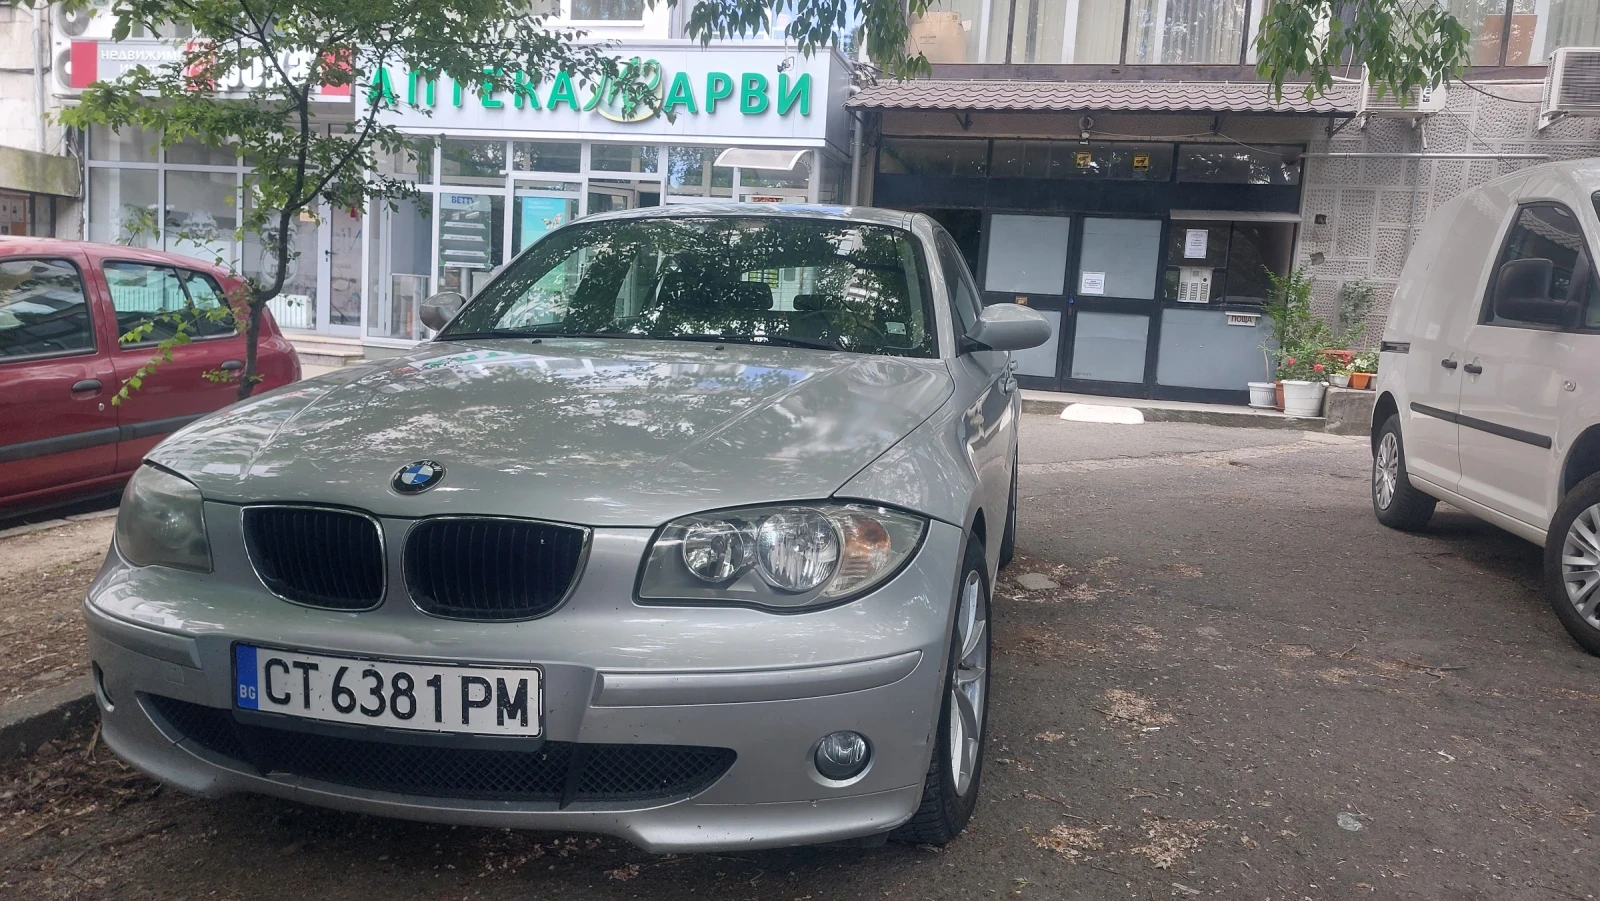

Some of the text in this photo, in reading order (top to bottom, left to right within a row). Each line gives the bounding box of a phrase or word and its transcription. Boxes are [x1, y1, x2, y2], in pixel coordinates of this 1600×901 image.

[366, 66, 579, 110] АПТЕКА
[1231, 315, 1253, 324] ПОЩА
[239, 683, 256, 700] BG
[264, 657, 529, 728] CT 6381 PM
